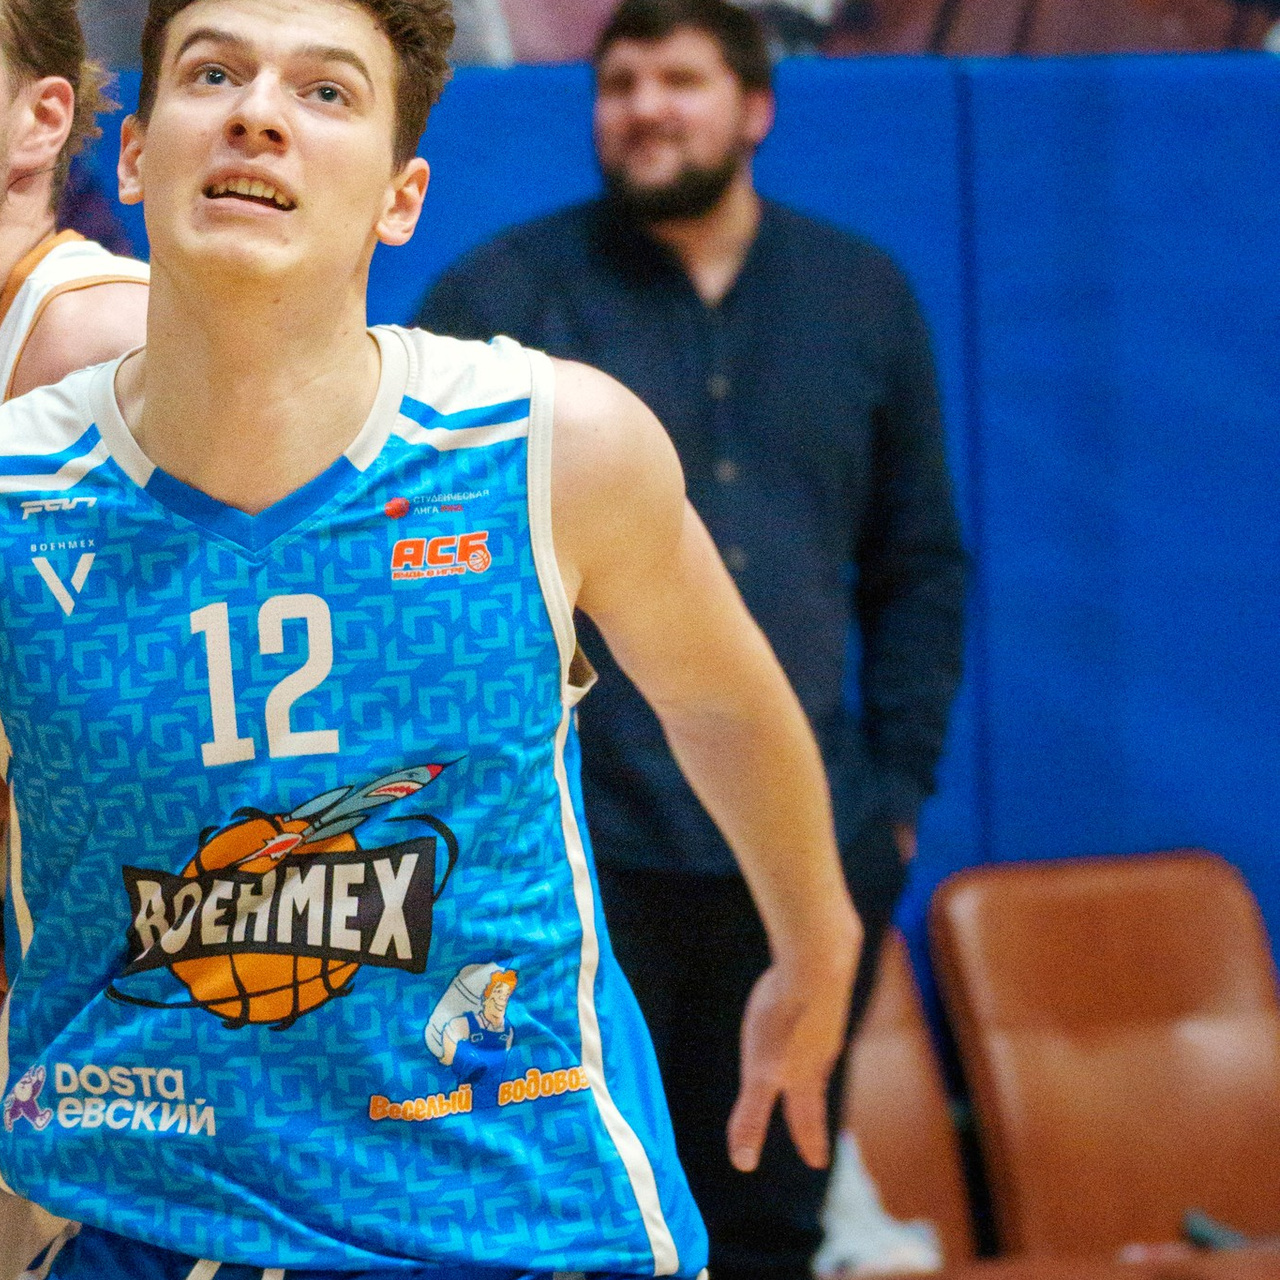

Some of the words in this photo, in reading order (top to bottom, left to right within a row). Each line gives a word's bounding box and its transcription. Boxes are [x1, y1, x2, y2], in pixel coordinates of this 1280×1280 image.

[30, 539, 95, 552] ВОЕНМЕХ
[391, 530, 492, 573] АСБ
[190, 593, 340, 767] 12
[133, 852, 420, 962] ВОЕНМЕХ
